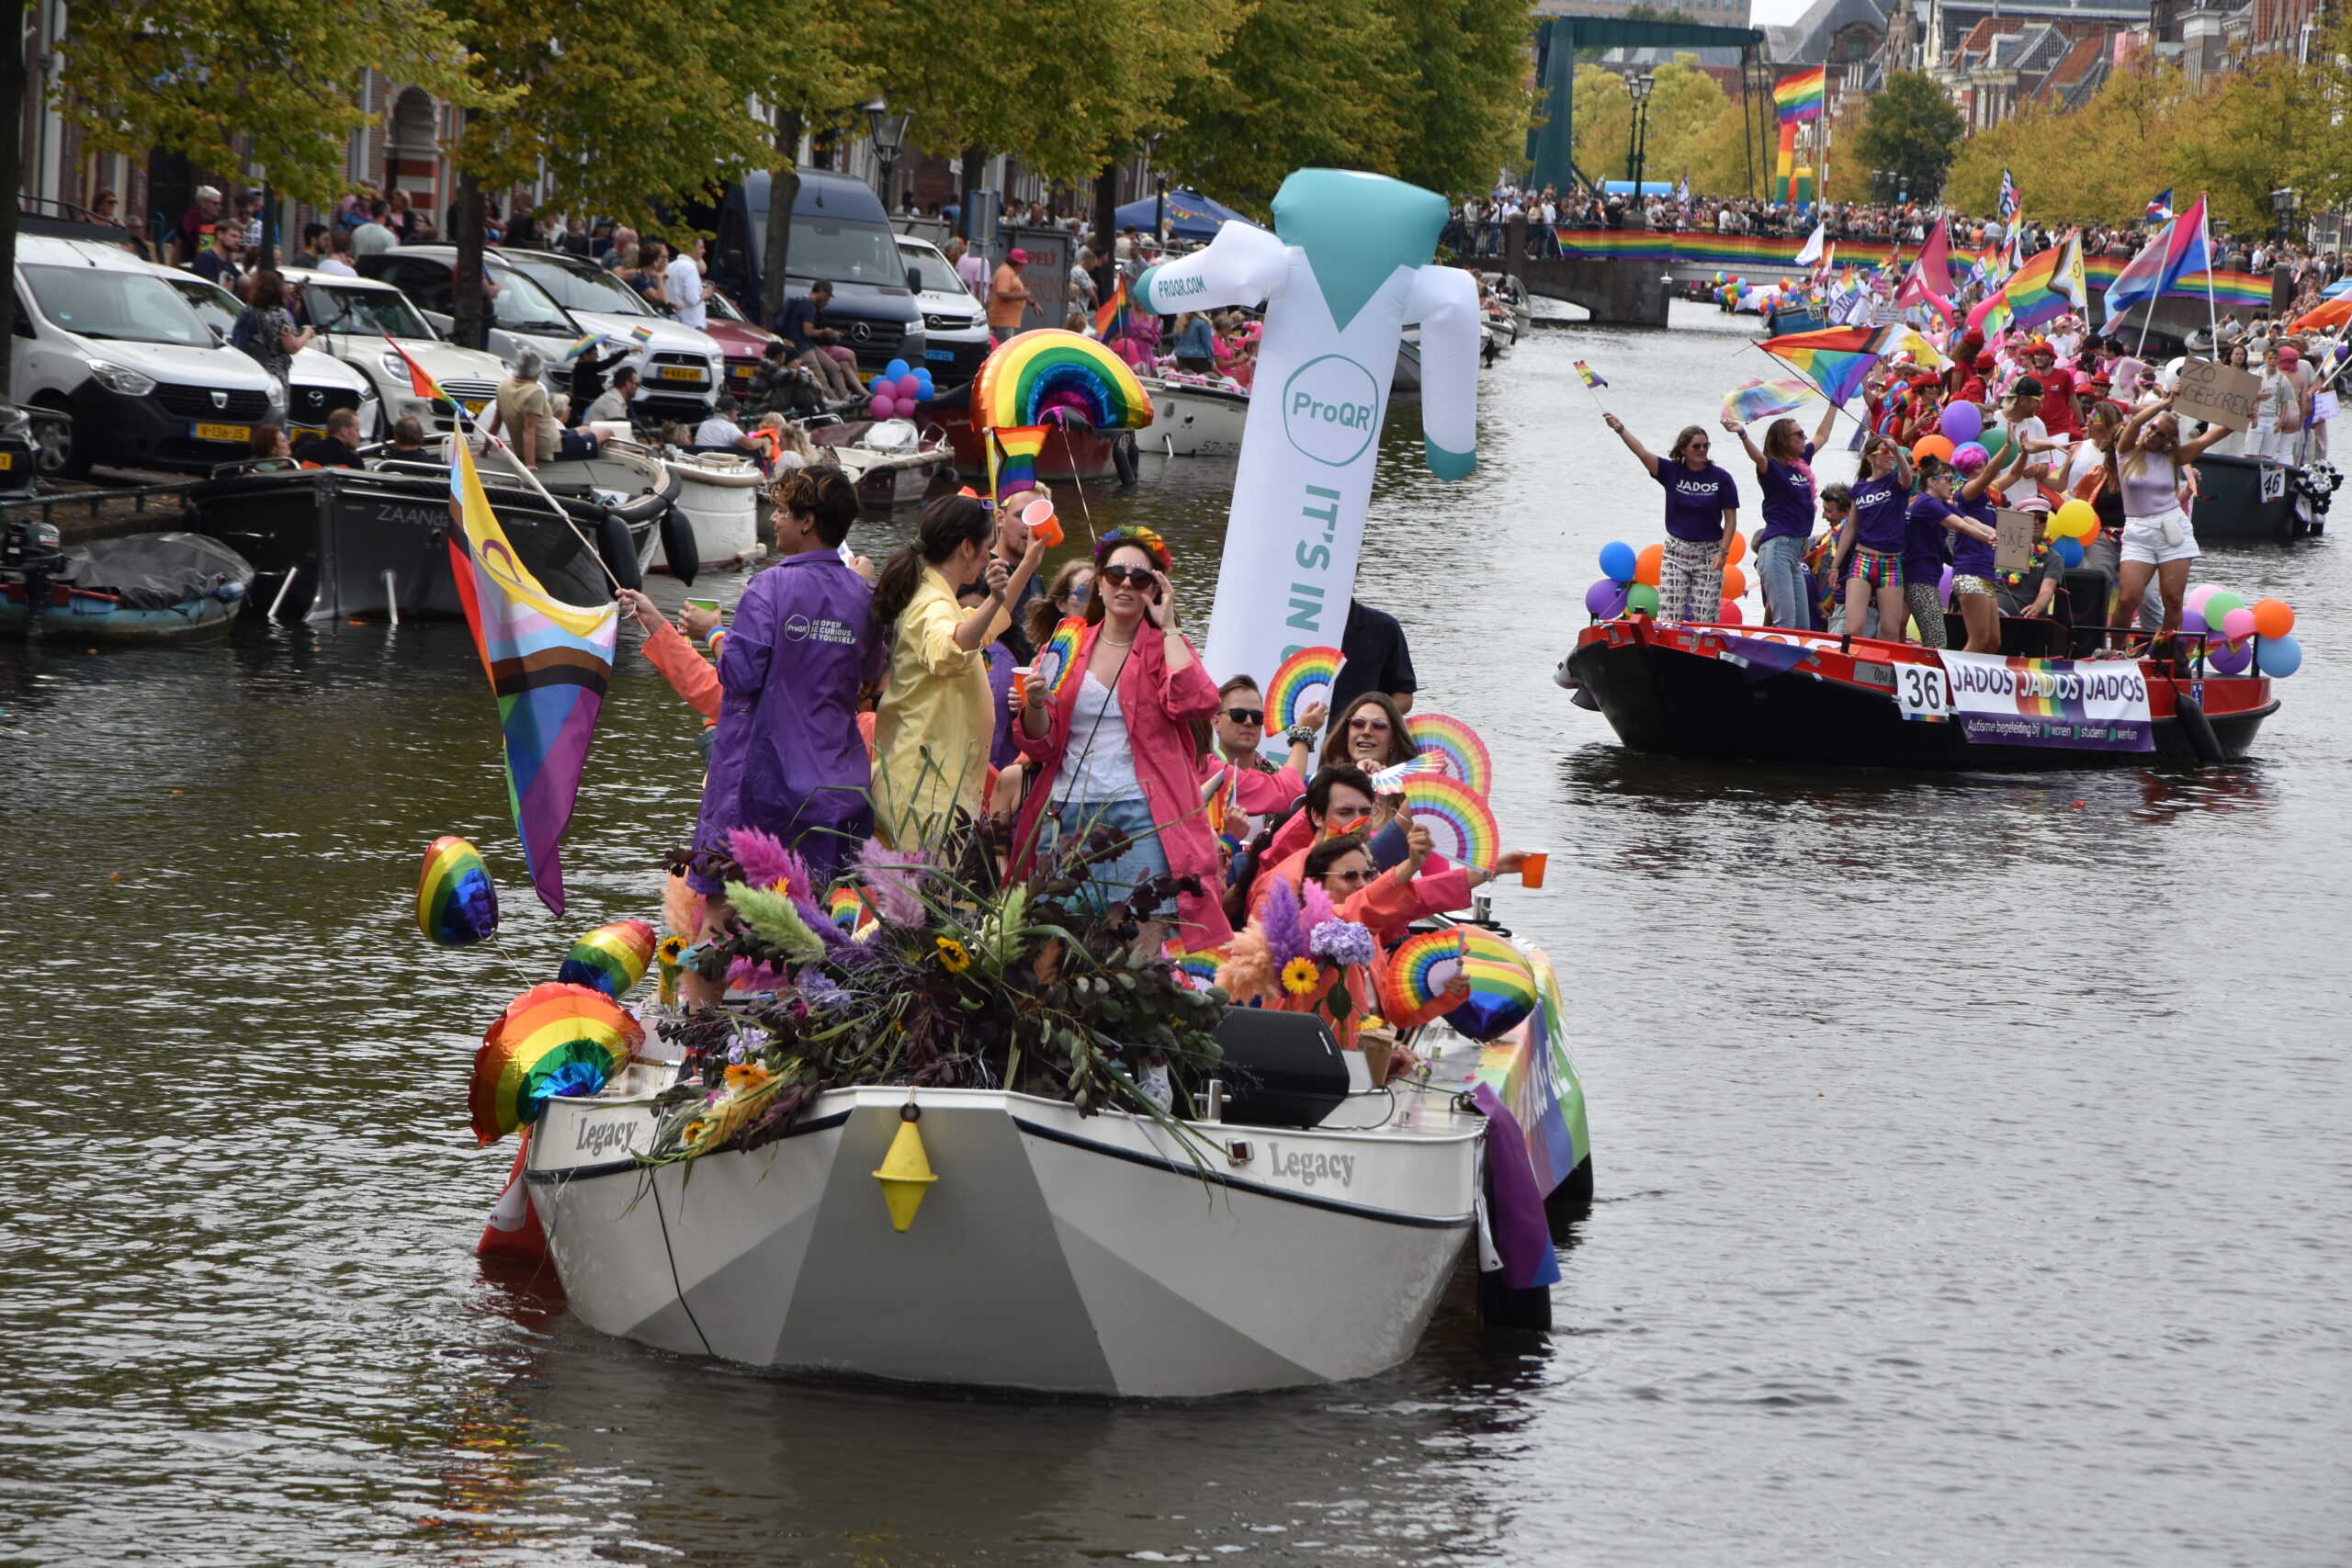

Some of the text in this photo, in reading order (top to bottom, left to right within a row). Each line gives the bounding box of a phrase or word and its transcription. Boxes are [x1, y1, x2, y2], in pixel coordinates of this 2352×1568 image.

[1158, 275, 1207, 298] PROQR.COM
[2182, 360, 2216, 384] ZO
[1676, 479, 1719, 492] JADOS
[2264, 473, 2280, 494] 46
[1295, 484, 1340, 571] IT'S
[1285, 582, 1325, 632] IN
[820, 620, 842, 628] OPEN
[820, 626, 852, 637] CURIOUS
[819, 634, 857, 645] YOURSELF
[1905, 669, 1940, 709] 36
[1953, 665, 2144, 703] JADOS JADOS JADOS
[1968, 719, 2138, 740] Autisme begeleiding bij wonen studeren werken
[576, 1117, 639, 1156] Legacy
[1268, 1142, 1355, 1188] Legacy
